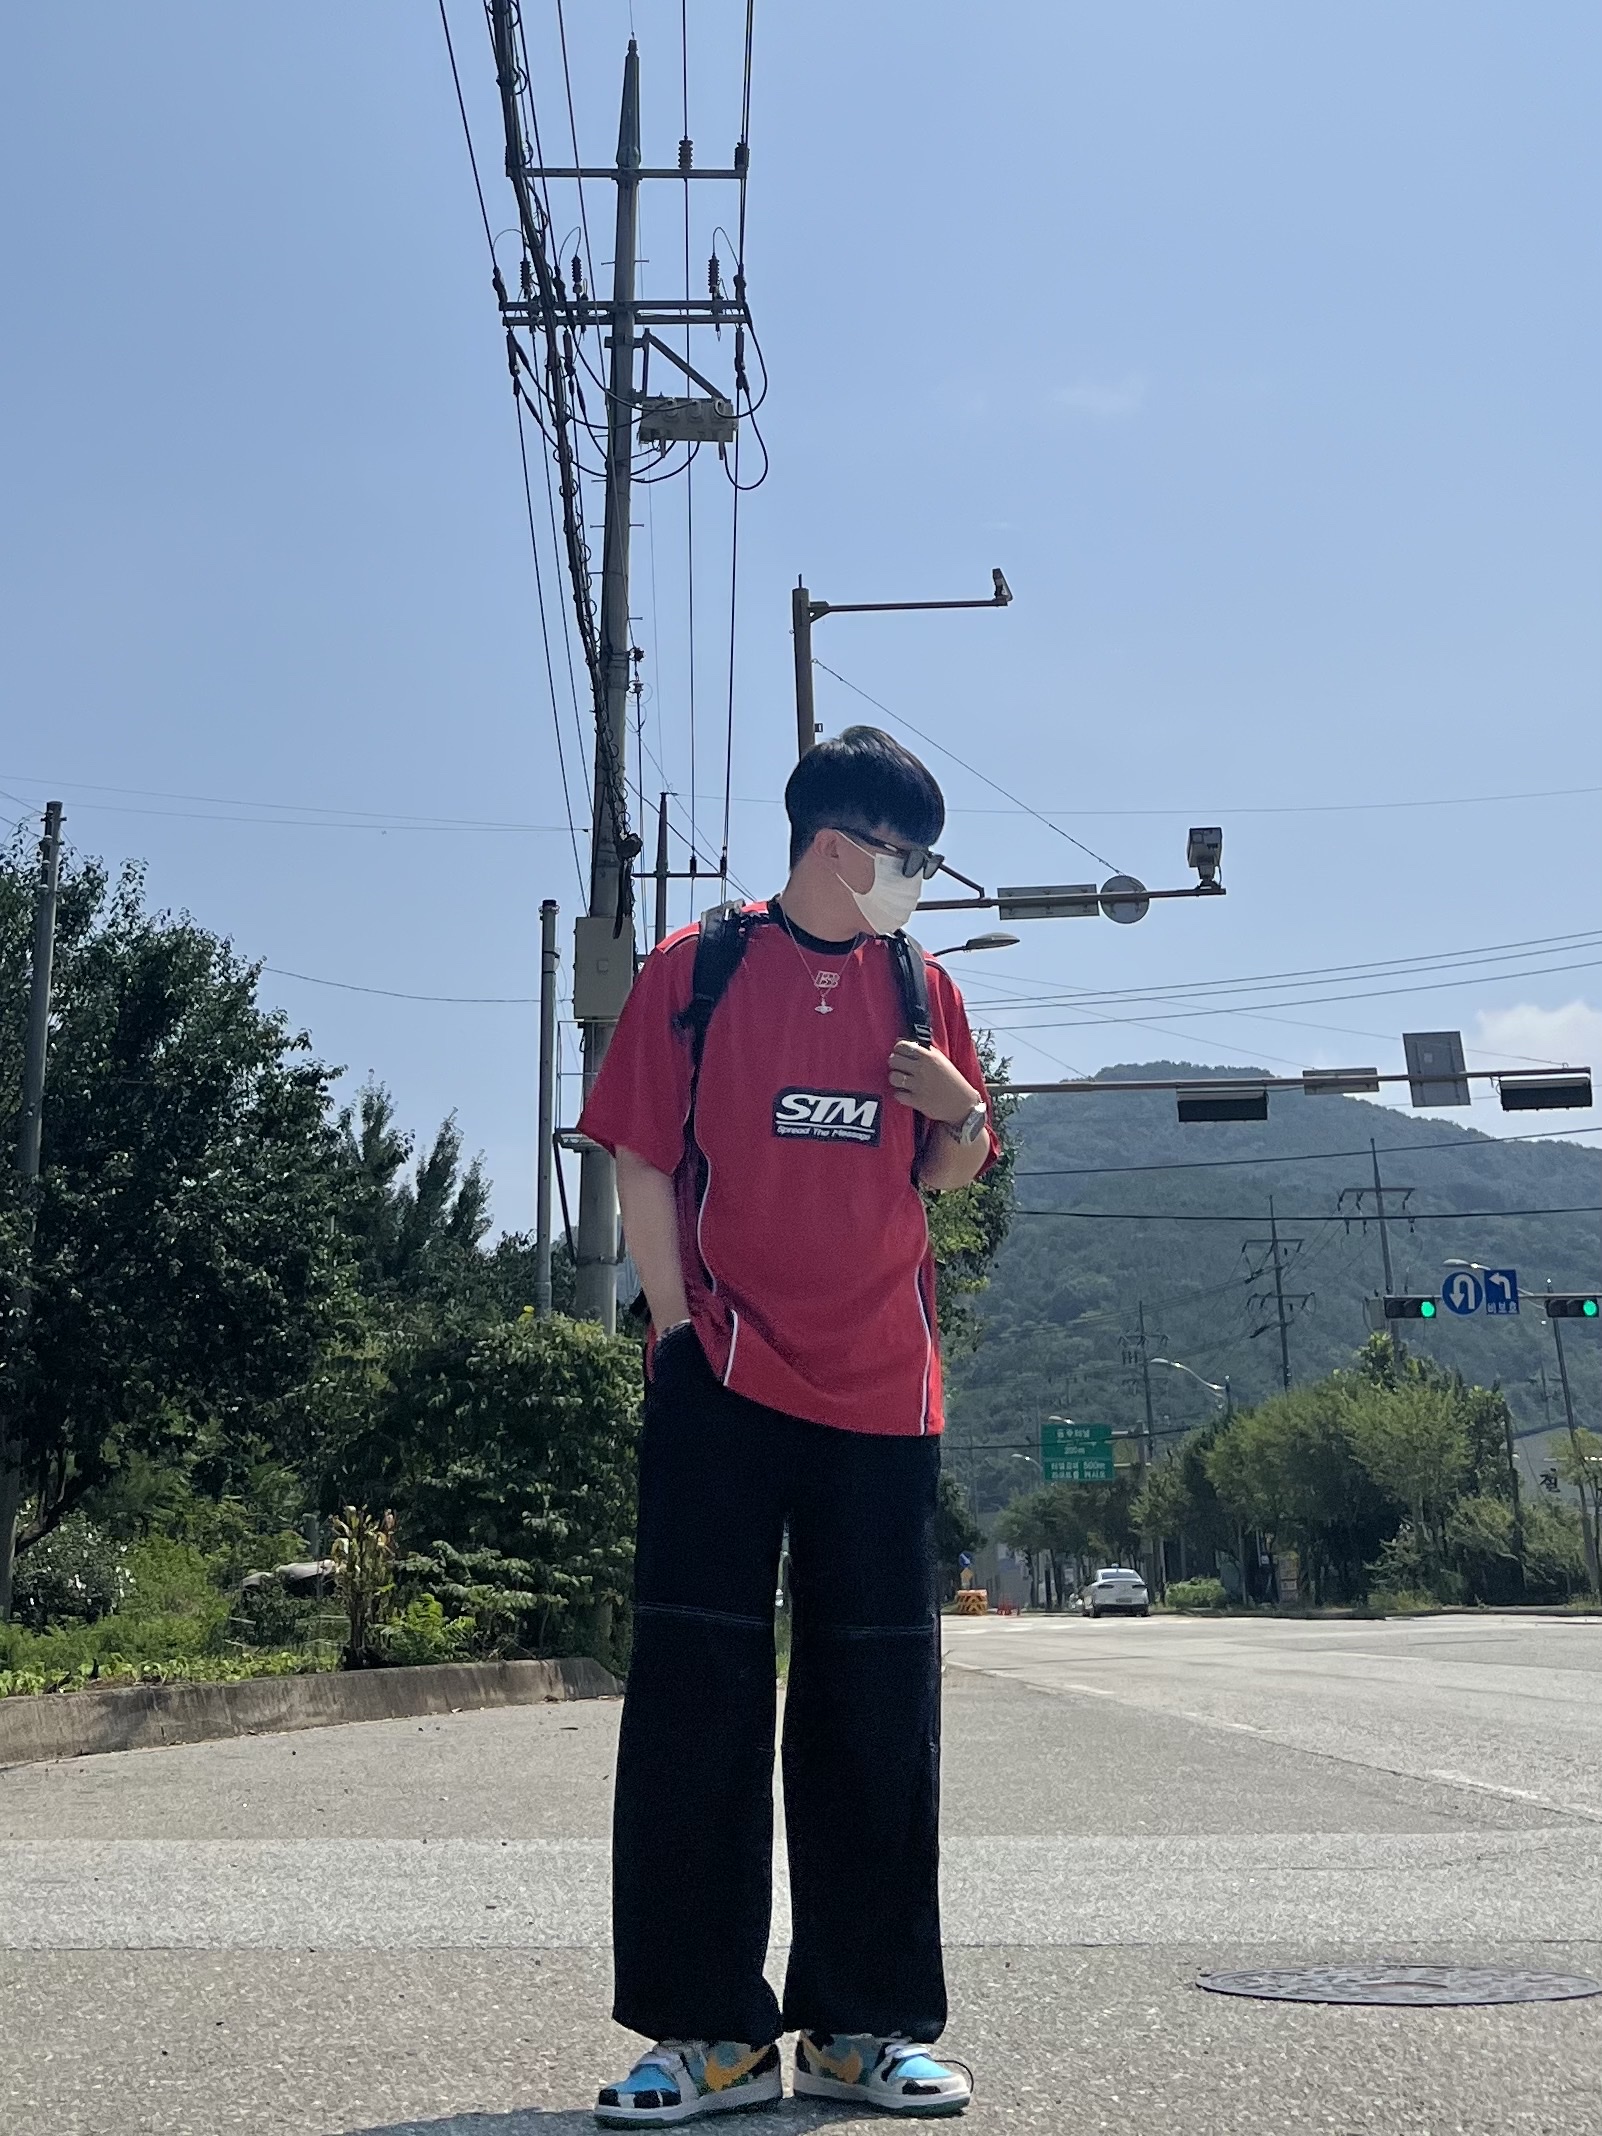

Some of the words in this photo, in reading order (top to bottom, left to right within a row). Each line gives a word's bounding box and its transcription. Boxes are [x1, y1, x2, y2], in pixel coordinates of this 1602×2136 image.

[775, 1093, 879, 1128] STM
[777, 1126, 811, 1135] Spread
[813, 1127, 830, 1136] The
[1487, 1301, 1517, 1313] 비보호
